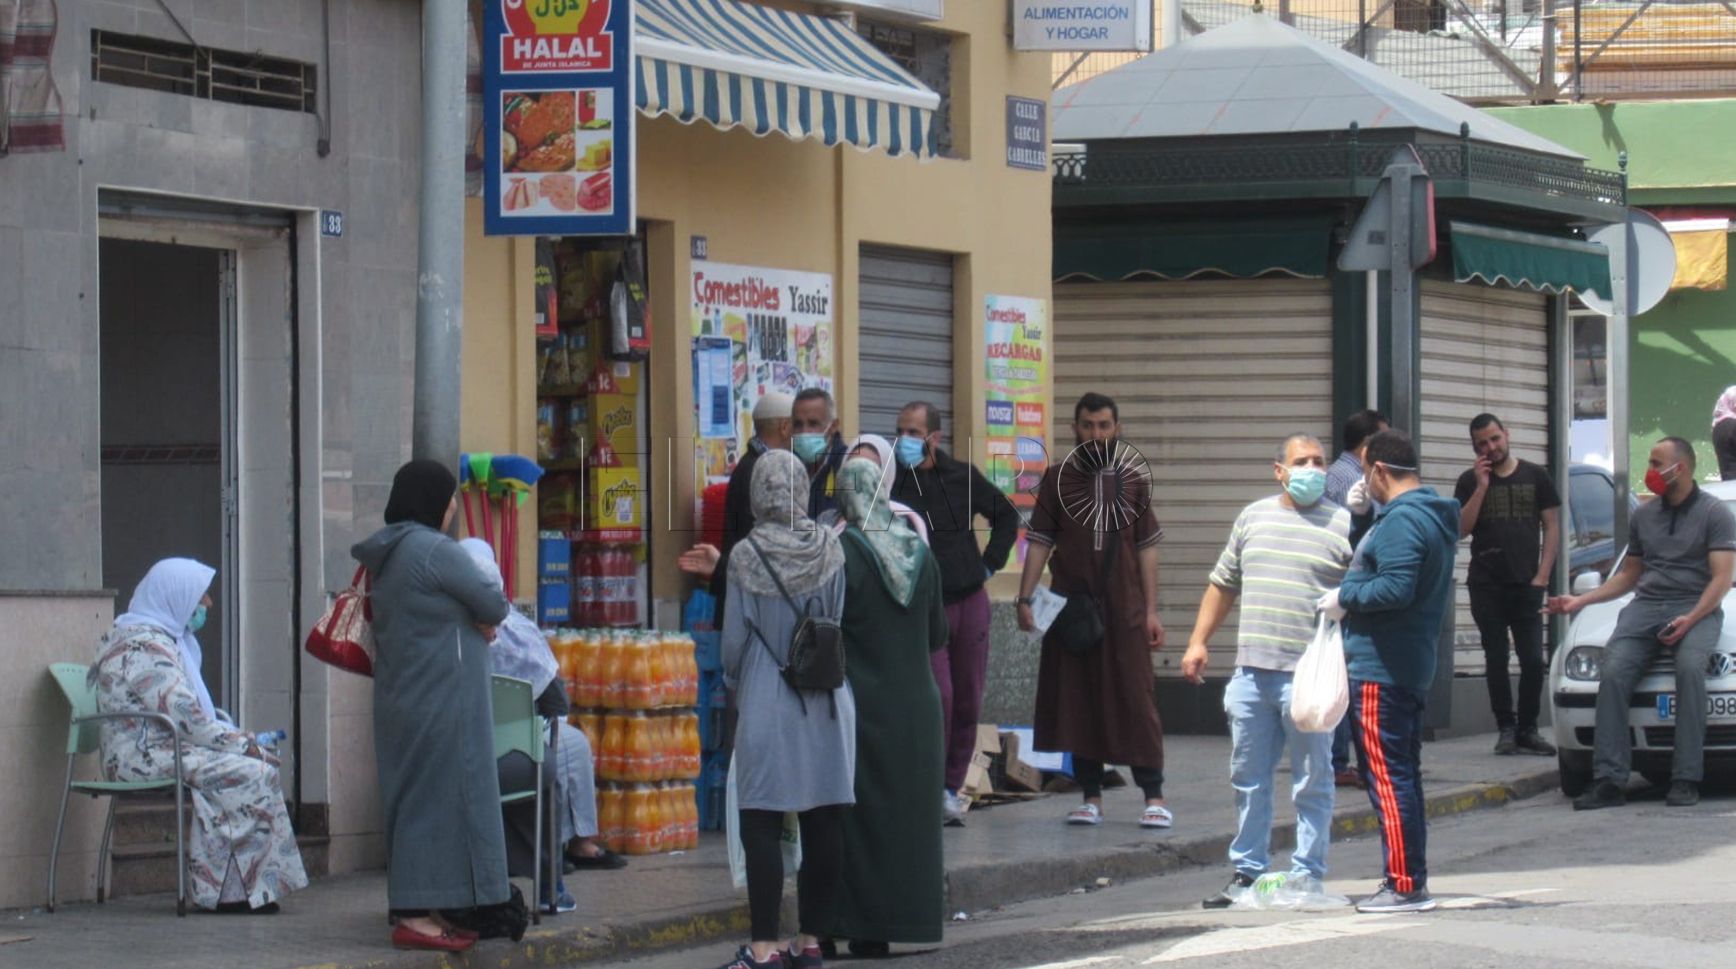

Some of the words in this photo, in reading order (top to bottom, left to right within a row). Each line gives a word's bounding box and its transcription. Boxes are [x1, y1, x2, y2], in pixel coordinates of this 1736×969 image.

[1023, 5, 1129, 19] ALIMENTACIÓN
[1045, 27, 1055, 39] Y
[1057, 27, 1109, 39] HOGAR
[513, 37, 603, 59] HALAL
[693, 271, 780, 311] Comestibles
[788, 285, 829, 316] Yassir
